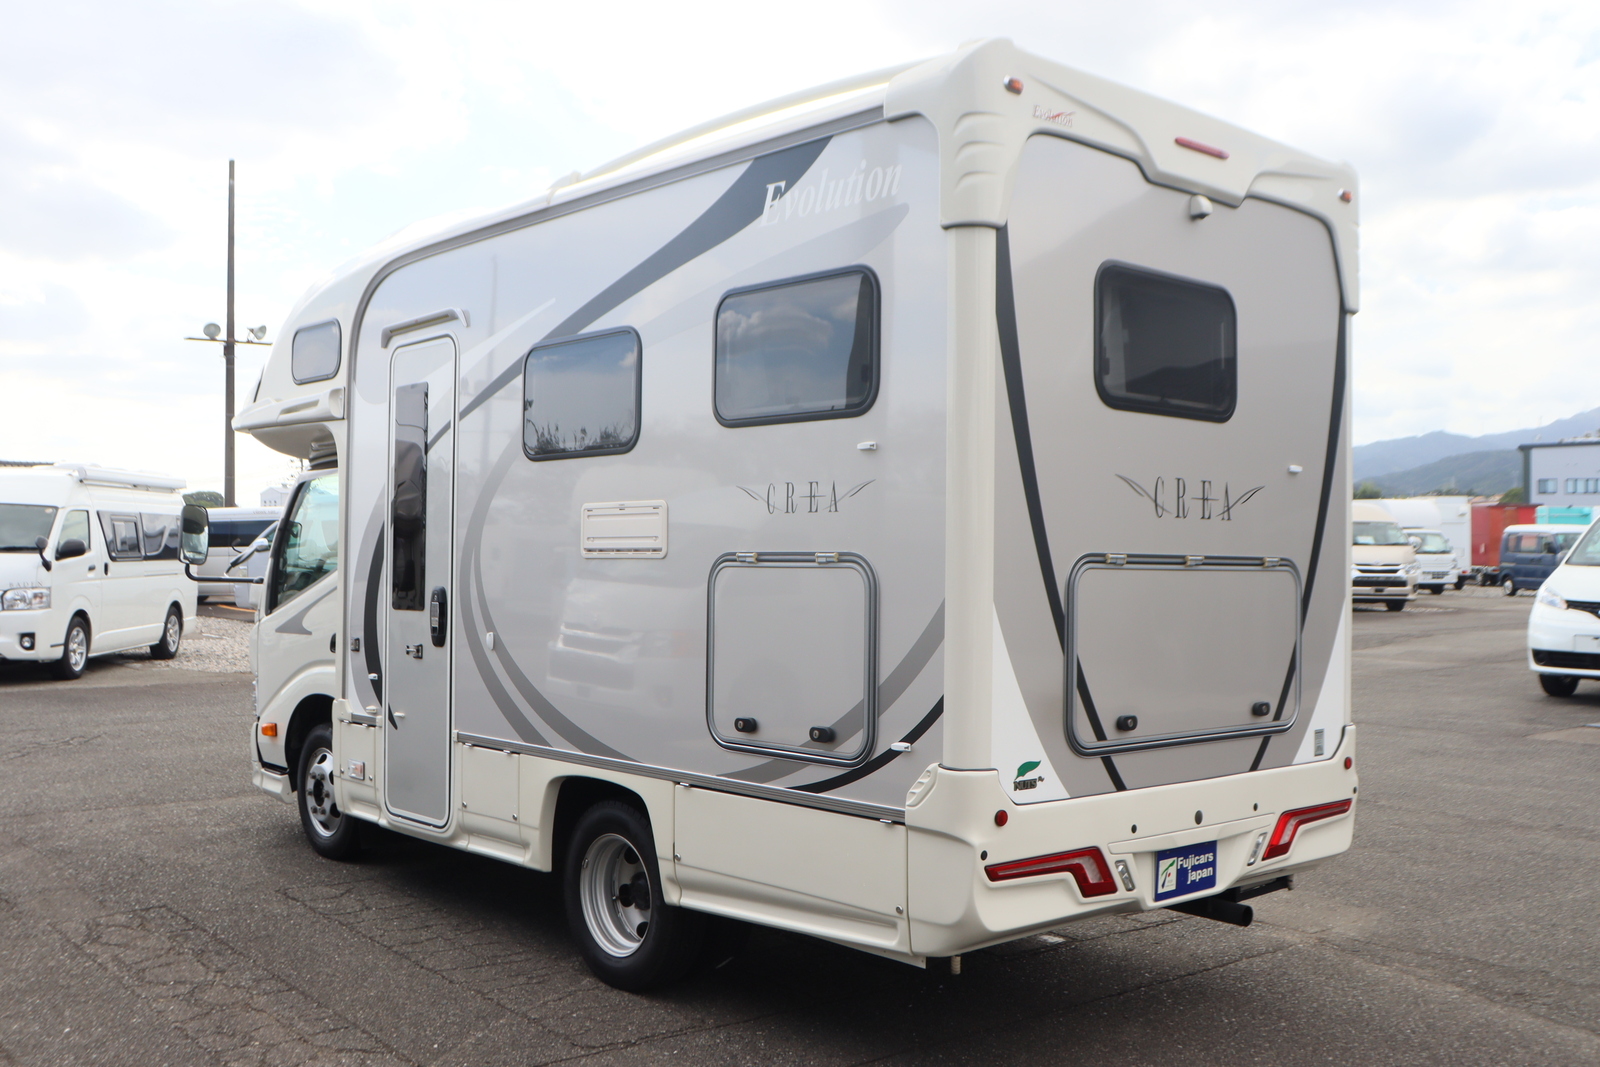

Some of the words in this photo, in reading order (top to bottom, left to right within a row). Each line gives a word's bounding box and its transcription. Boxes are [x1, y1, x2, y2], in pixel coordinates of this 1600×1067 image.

[759, 158, 902, 228] Evolution
[766, 480, 839, 514] CREA
[1154, 476, 1232, 521] CREA
[1177, 852, 1214, 870] Fujicars
[1187, 867, 1213, 885] japan
